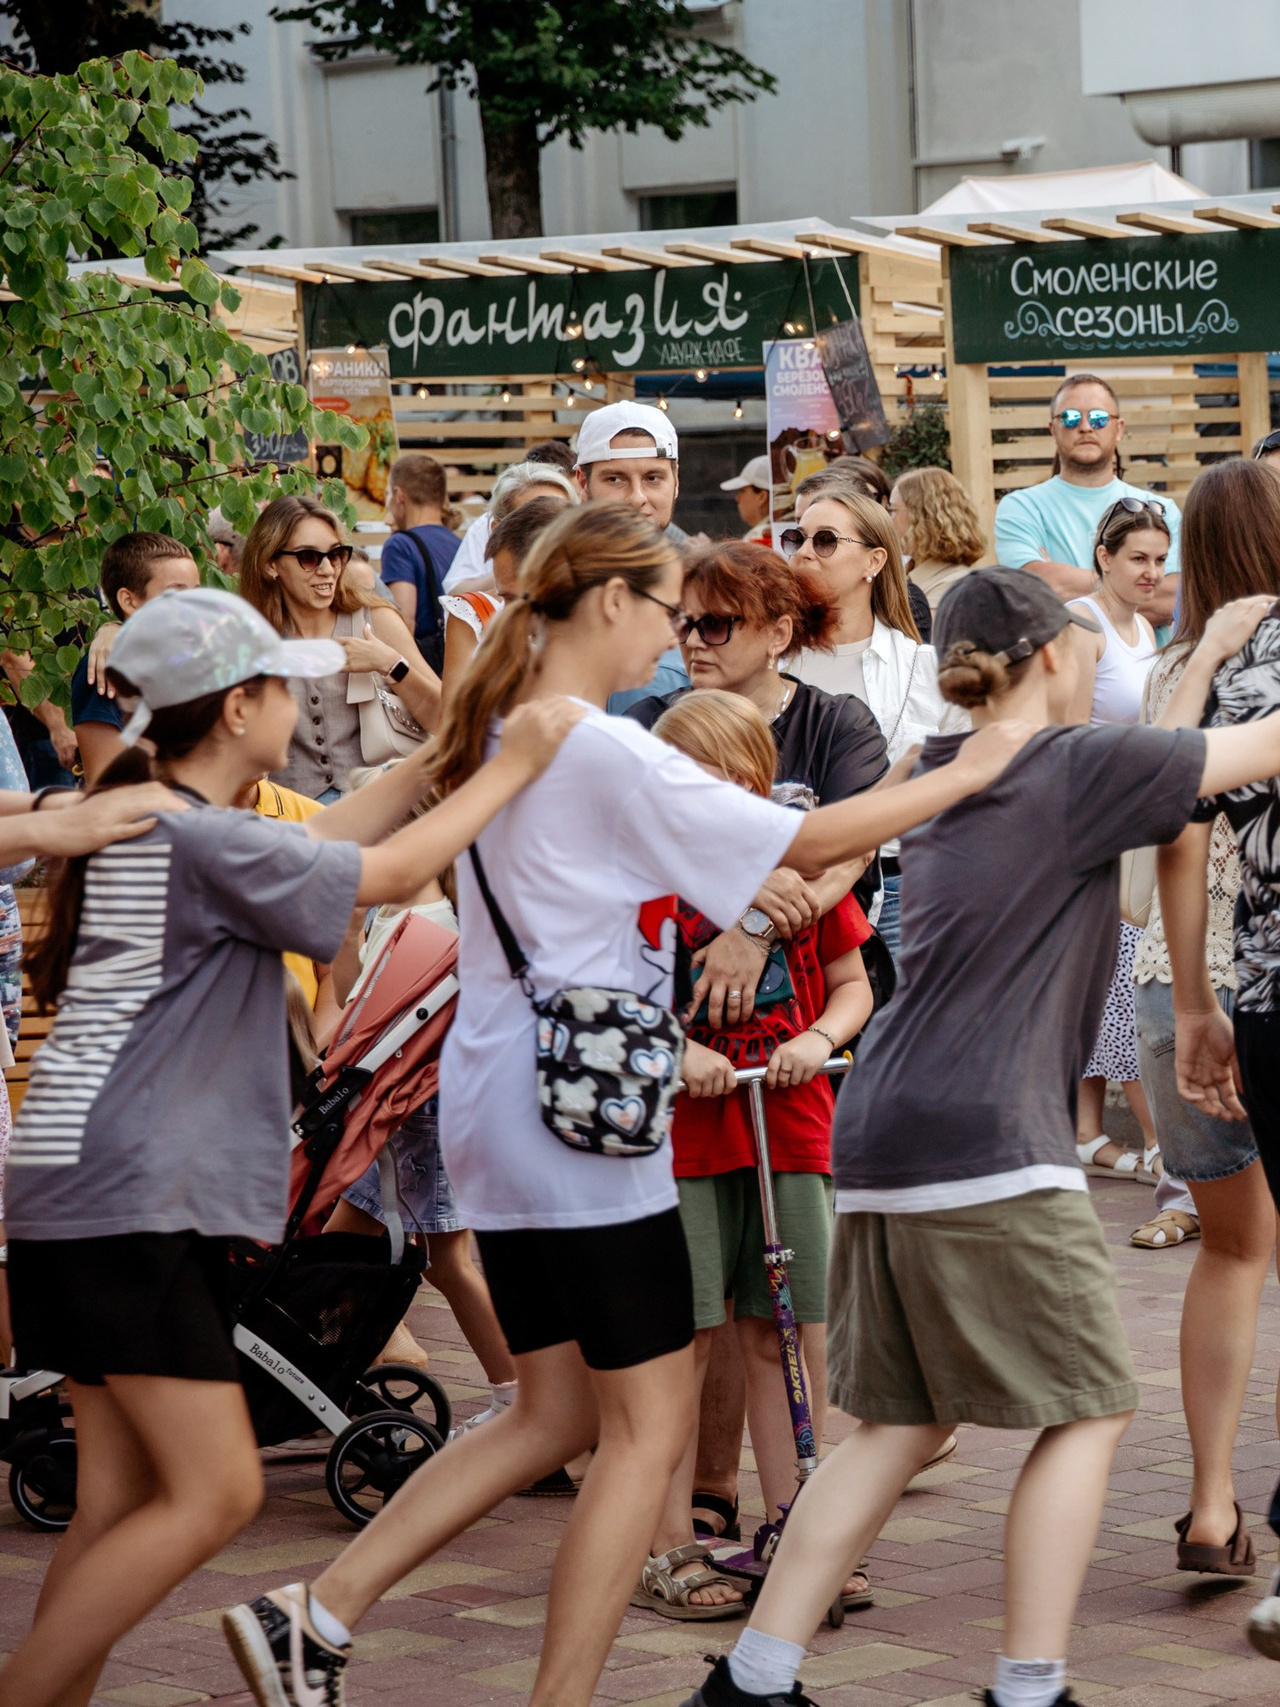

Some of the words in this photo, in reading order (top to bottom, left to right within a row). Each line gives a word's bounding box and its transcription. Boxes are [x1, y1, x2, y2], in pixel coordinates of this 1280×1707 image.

[1010, 256, 1219, 296] Смоленские
[1055, 303, 1185, 339] сезоны
[318, 1087, 350, 1115] Babalo
[249, 1342, 285, 1375] Babalo
